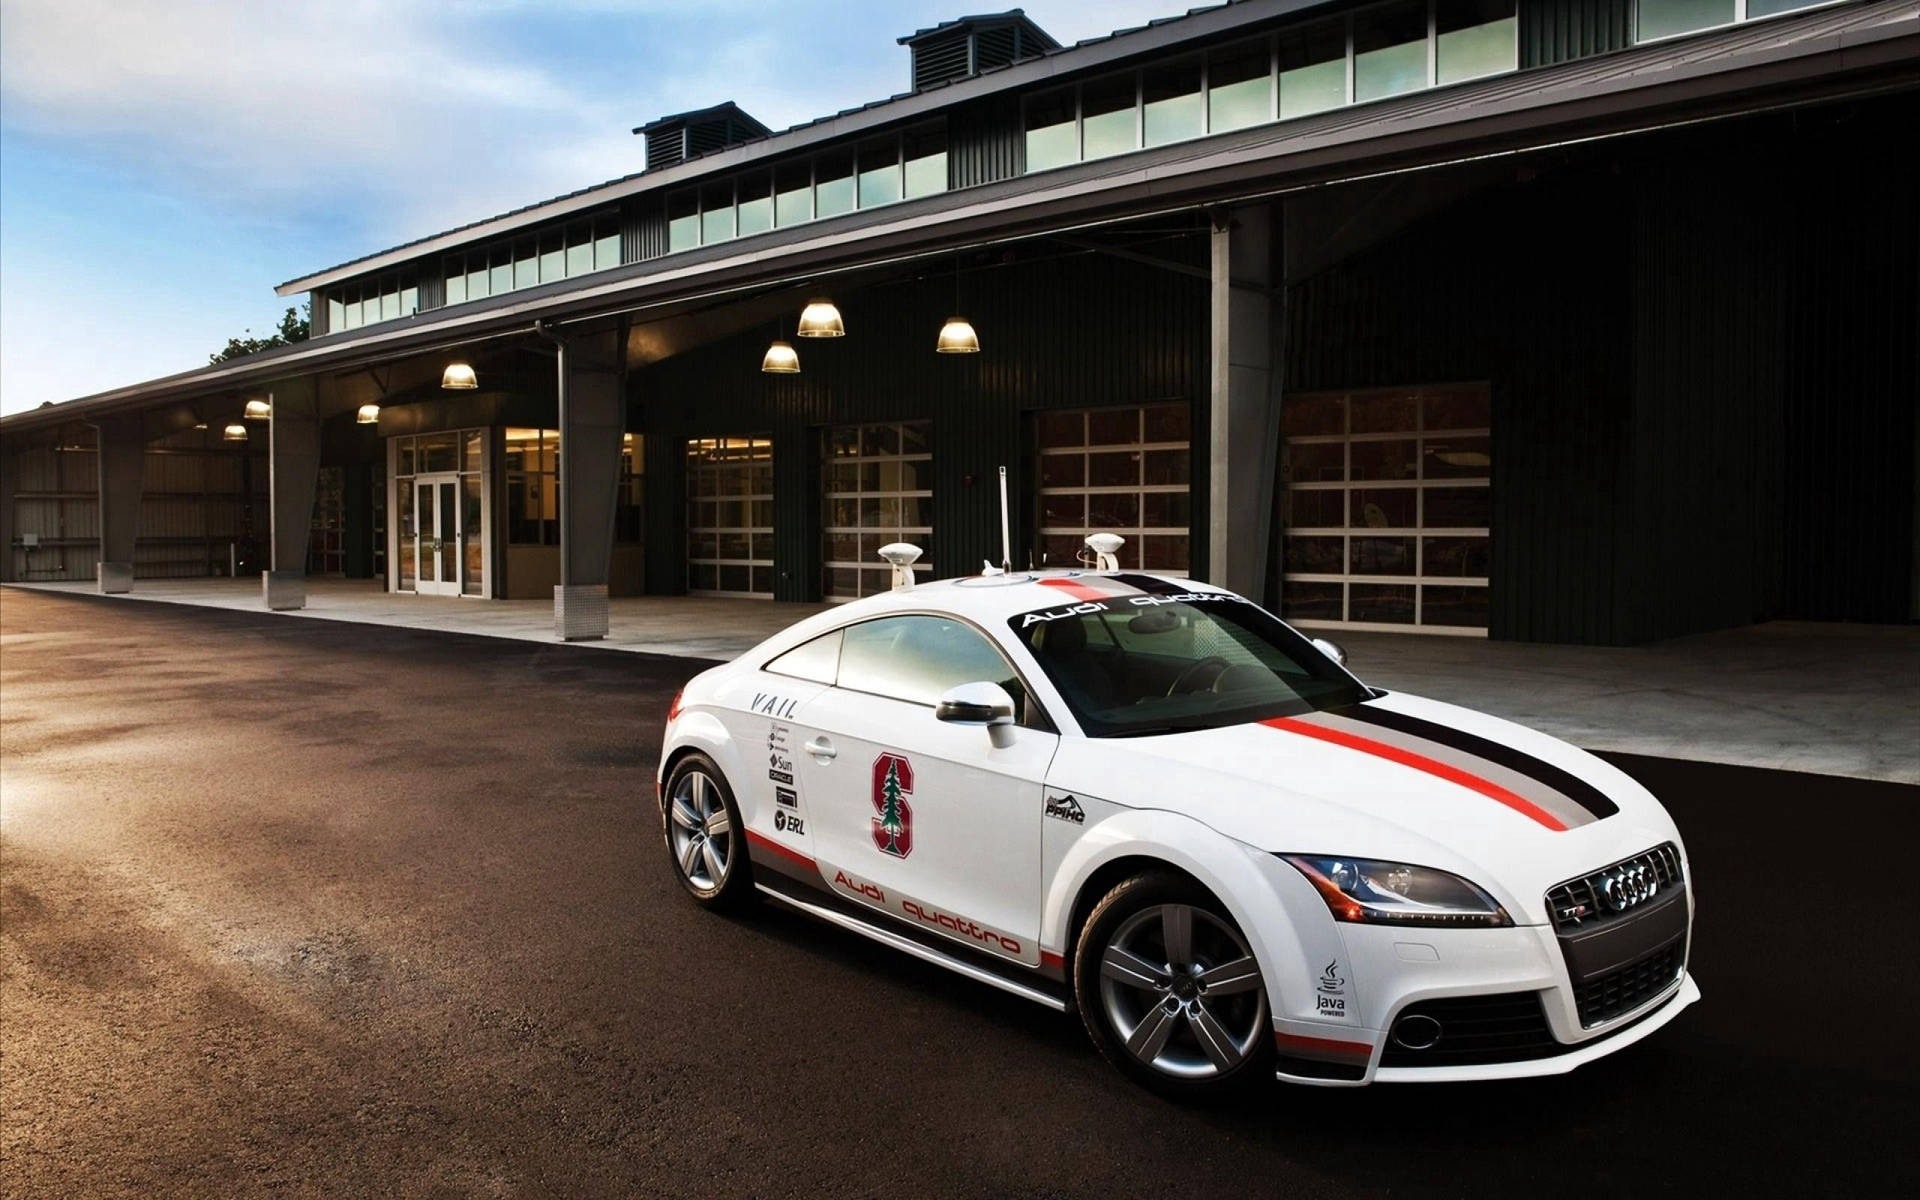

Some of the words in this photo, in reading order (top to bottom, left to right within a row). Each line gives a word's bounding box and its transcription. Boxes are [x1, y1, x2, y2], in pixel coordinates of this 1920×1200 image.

[1022, 602, 1109, 628] Audi
[751, 692, 798, 719] VAIL
[777, 755, 793, 771] Sun
[787, 815, 805, 835] ERL
[834, 870, 886, 903] Audi
[902, 899, 1021, 954] quattro
[1316, 994, 1345, 1010] Java
[1320, 1009, 1345, 1017] POWERED
